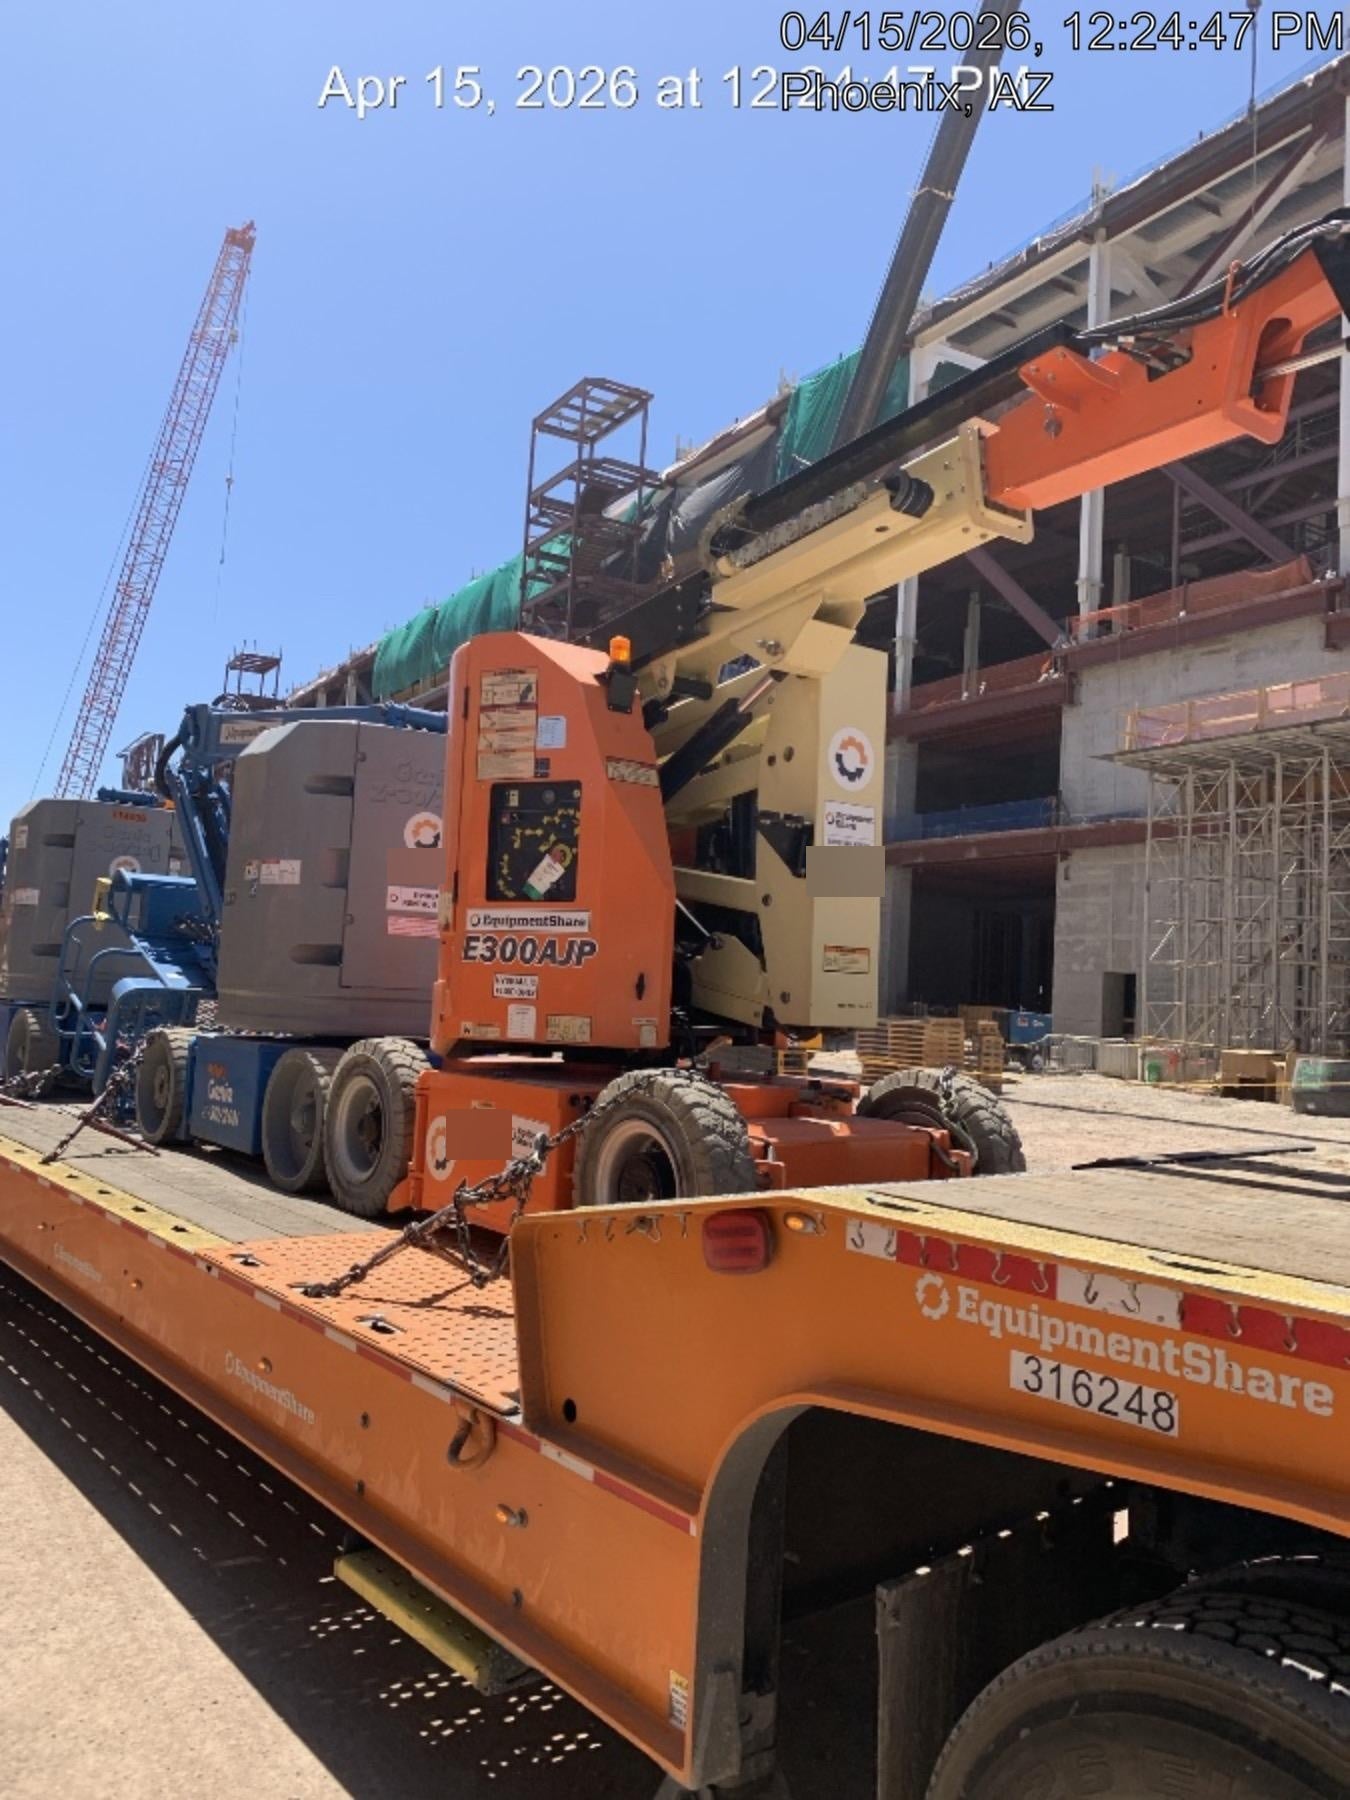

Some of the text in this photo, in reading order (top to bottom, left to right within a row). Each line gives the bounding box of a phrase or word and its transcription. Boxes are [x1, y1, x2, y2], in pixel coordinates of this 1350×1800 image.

[482, 914, 587, 929] EquipmentShare
[461, 934, 599, 968] E300AJP
[955, 1285, 1335, 1418] EquipmentShare
[1022, 1354, 1177, 1434] 316248
